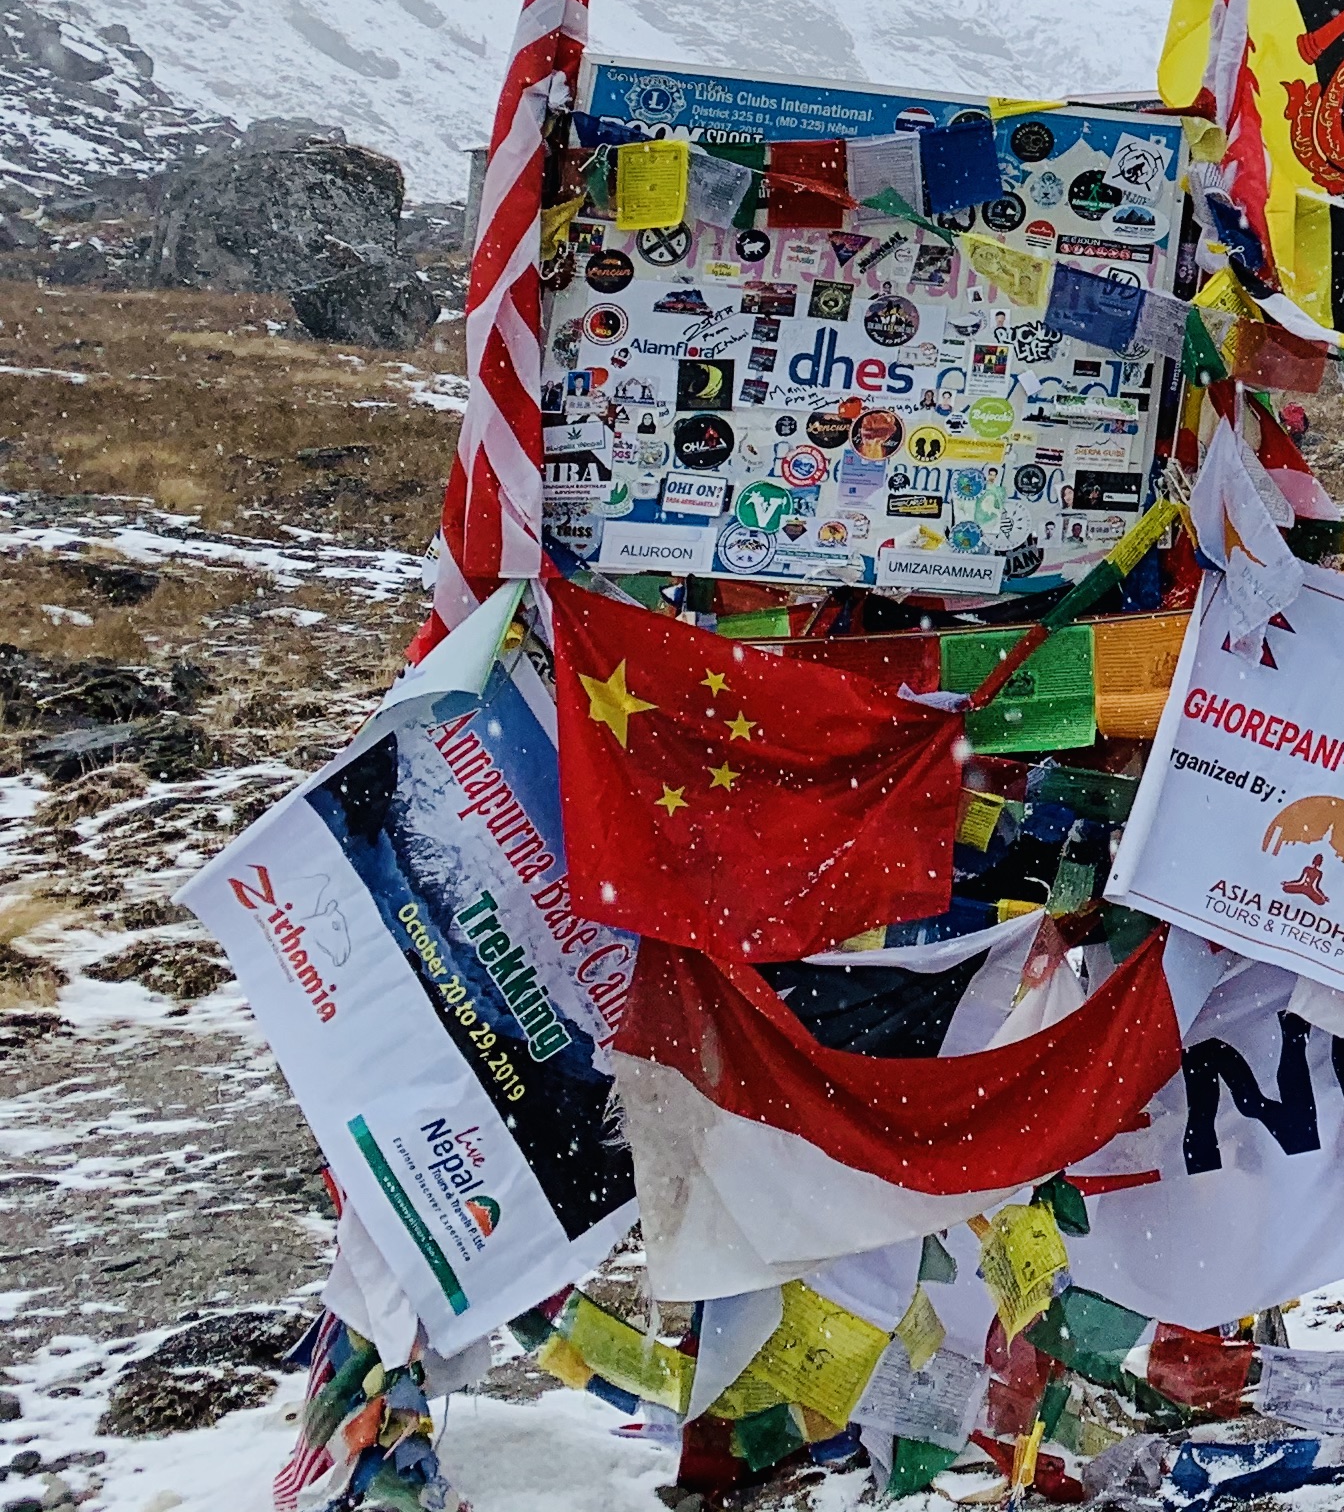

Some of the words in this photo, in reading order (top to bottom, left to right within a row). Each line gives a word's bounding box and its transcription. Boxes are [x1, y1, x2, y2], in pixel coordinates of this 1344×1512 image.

[737, 91, 777, 109] Clubs
[781, 96, 872, 122] International
[630, 337, 715, 360] Alamflora
[788, 326, 915, 395] dhes
[426, 707, 553, 884] Annapurna
[1204, 894, 1261, 928] TOURS
[1263, 919, 1275, 933] &
[1280, 922, 1332, 954] TREKS
[1208, 879, 1262, 911] ASIA
[398, 902, 448, 978] October
[438, 974, 467, 1004] 20
[454, 999, 477, 1027] to
[487, 1051, 526, 1102] 2019
[454, 889, 573, 1063] Trekking
[420, 1117, 485, 1195] Nepal
[431, 1168, 451, 1192] Tours
[414, 1172, 442, 1213] Discover
[439, 1213, 472, 1263] Experience
